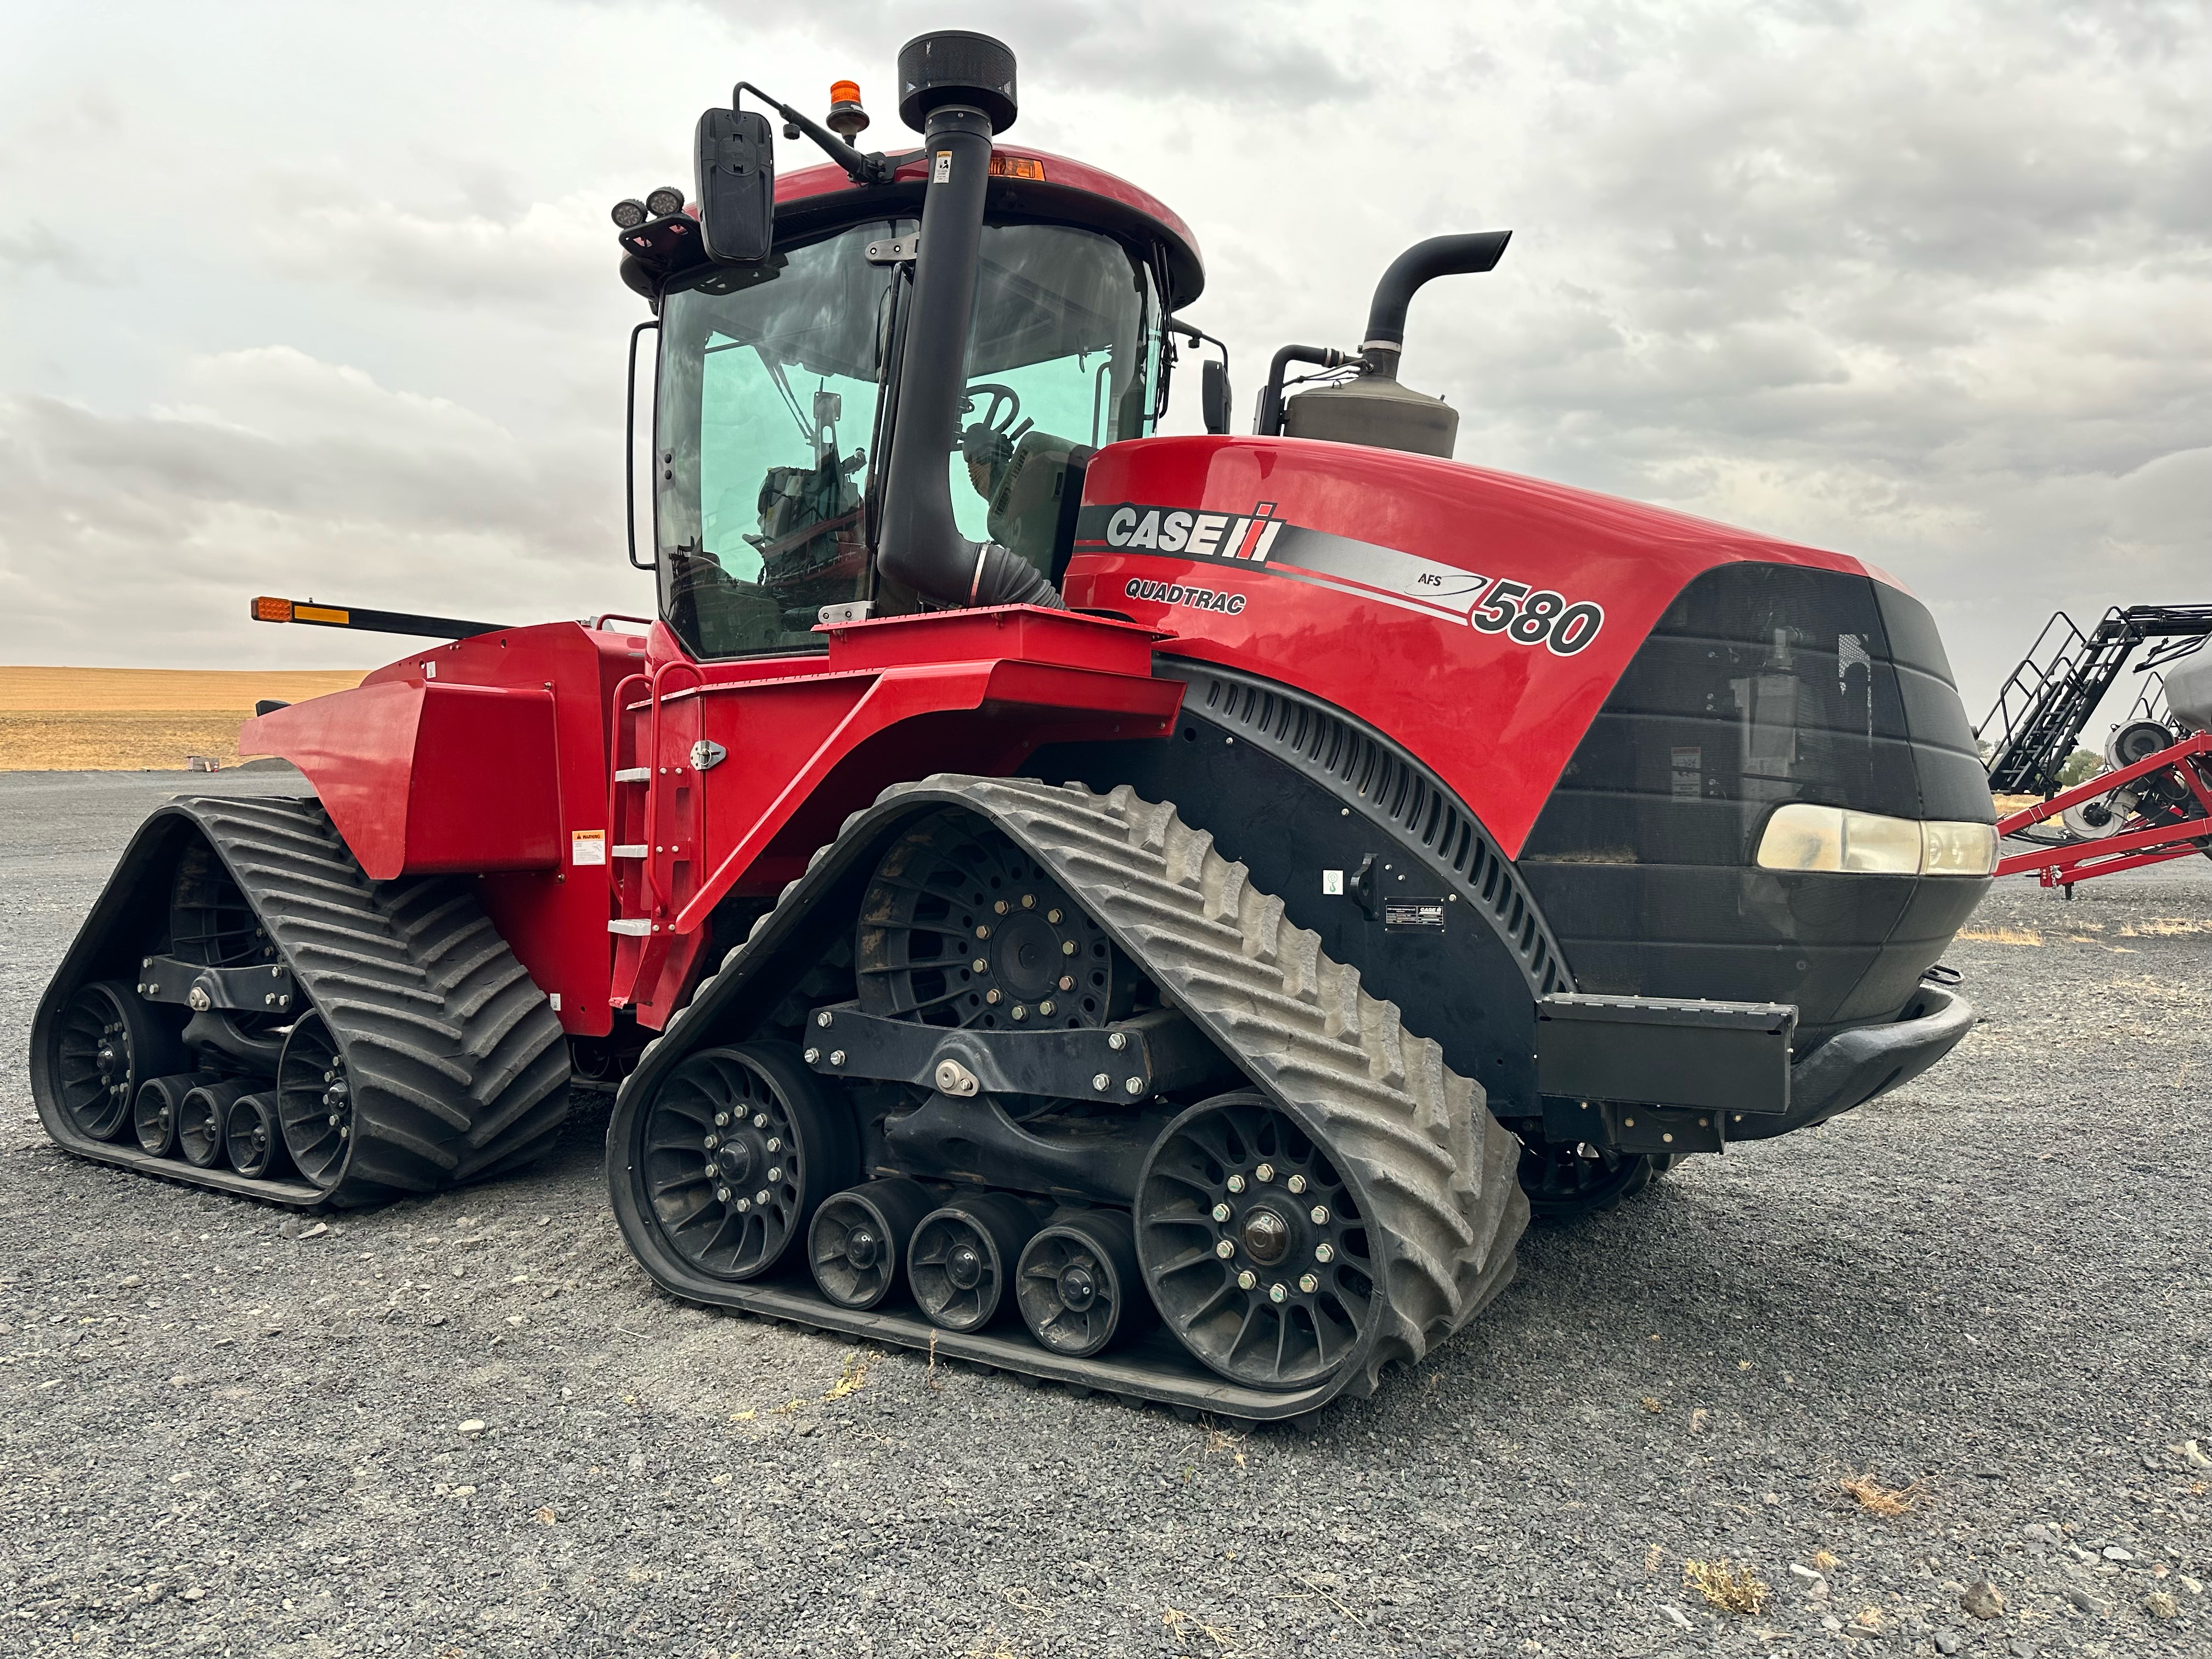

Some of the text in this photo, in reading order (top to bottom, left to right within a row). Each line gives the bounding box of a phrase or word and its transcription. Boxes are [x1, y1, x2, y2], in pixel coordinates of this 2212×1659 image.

[1107, 507, 1229, 555] CASE
[1125, 578, 1246, 616] QUADTRAC
[1418, 573, 1442, 586] AFS
[1471, 578, 1605, 657] 580
